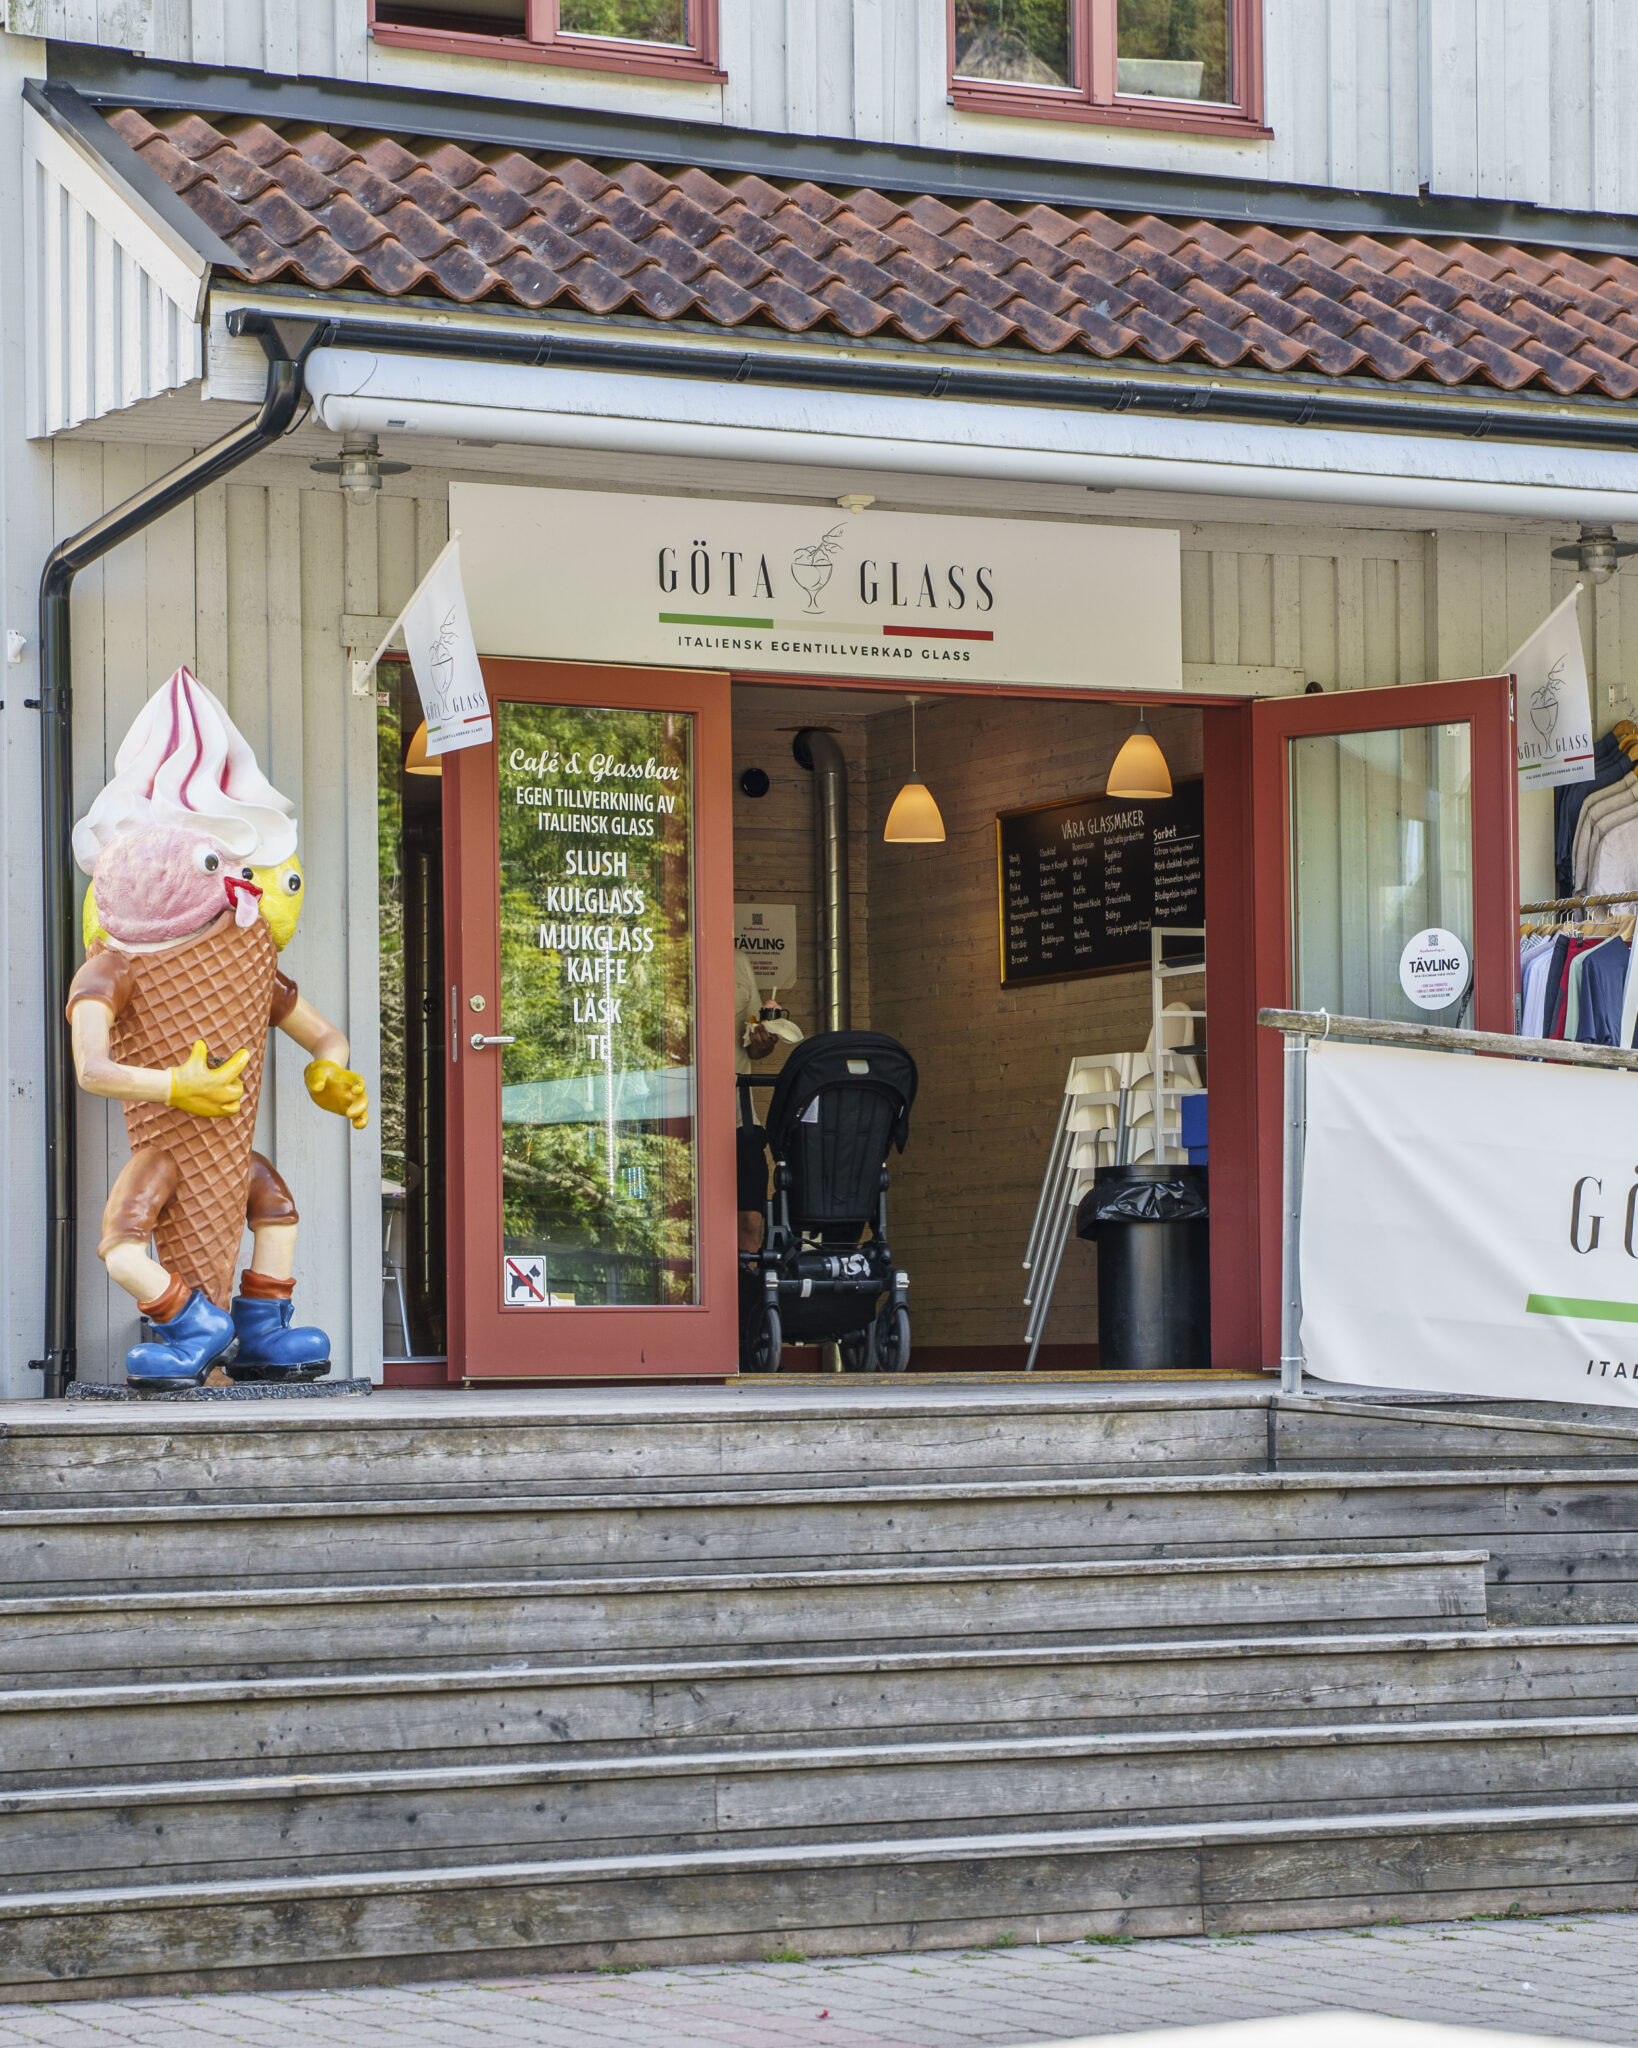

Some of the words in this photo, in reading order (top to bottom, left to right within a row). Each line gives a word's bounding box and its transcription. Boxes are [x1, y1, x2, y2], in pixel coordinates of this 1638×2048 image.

[658, 539, 776, 599] GÖTA
[859, 559, 994, 612] GLASS
[678, 636, 763, 651] ITALIENSK
[771, 641, 913, 659] EGENTILLVERKAD
[921, 649, 971, 662] GLASS
[1556, 733, 1589, 753] GLASS
[509, 748, 560, 779] Café
[565, 752, 582, 775] &
[589, 753, 680, 783] Glassbar
[516, 786, 553, 807] EGEN
[555, 788, 654, 813] TILLVERKNING
[657, 795, 676, 814] AV
[538, 812, 608, 834] ITALIENSK
[611, 816, 654, 836] GLASS
[1061, 819, 1085, 840] VÅRA
[1087, 810, 1145, 835] GLASSMAKER
[1153, 825, 1176, 841] Sorbet
[565, 850, 627, 877] SLUSH
[547, 886, 645, 915] KULGLASS
[539, 923, 654, 953] MJUKGLASS
[734, 934, 785, 951] TÄVLING
[567, 956, 627, 985] KAFFE
[1409, 957, 1460, 973] TÄVLING
[573, 992, 622, 1024] LÄSK
